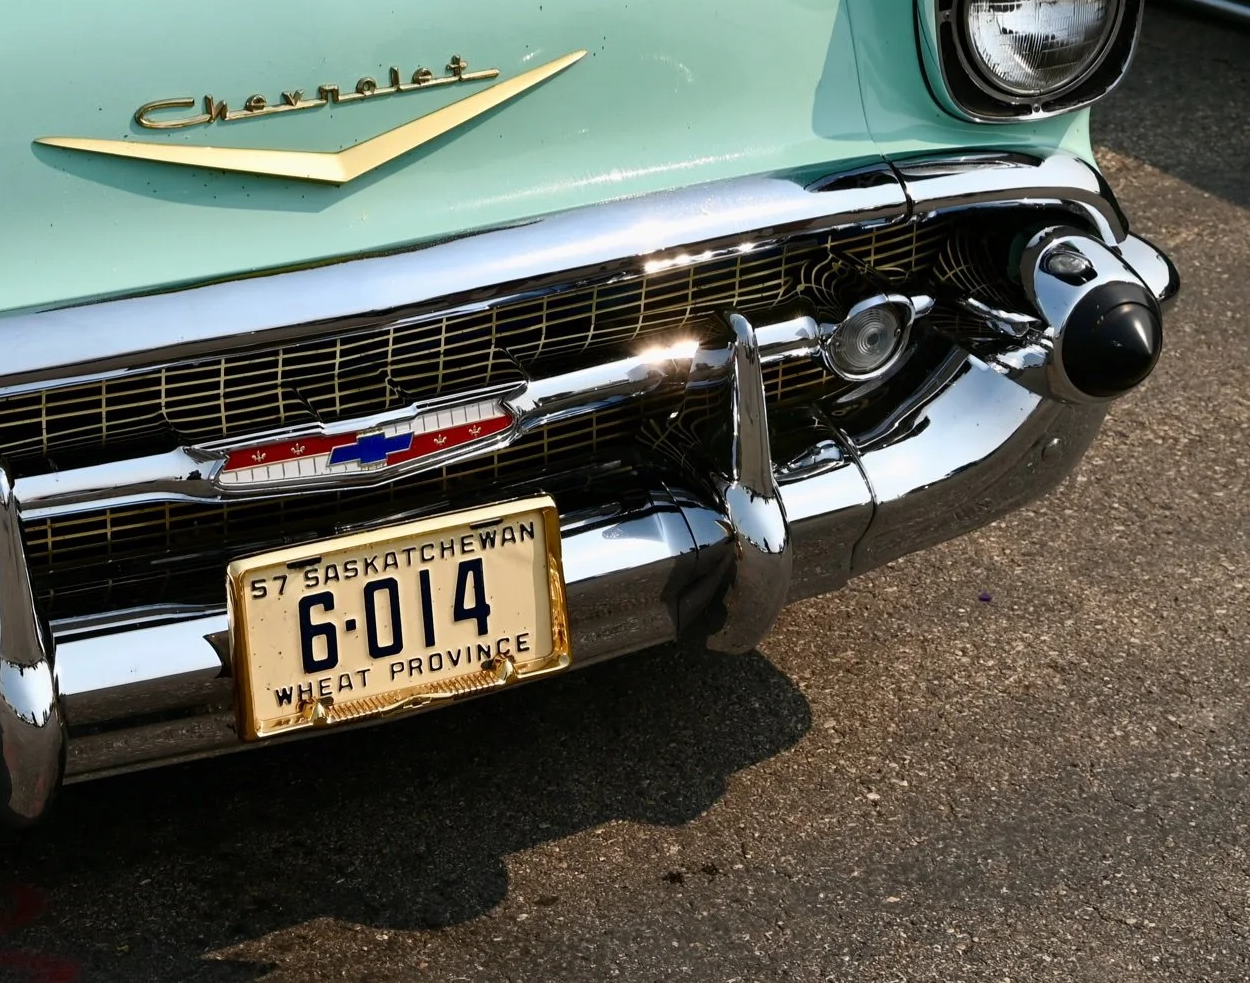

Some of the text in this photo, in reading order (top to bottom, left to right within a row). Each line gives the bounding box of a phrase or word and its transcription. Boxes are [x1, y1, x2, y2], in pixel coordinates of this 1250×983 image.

[134, 54, 500, 129] Chevrolet
[251, 521, 536, 599] 57 SASKATCHEWAN
[275, 632, 531, 707] WHEAT PROVINCE
